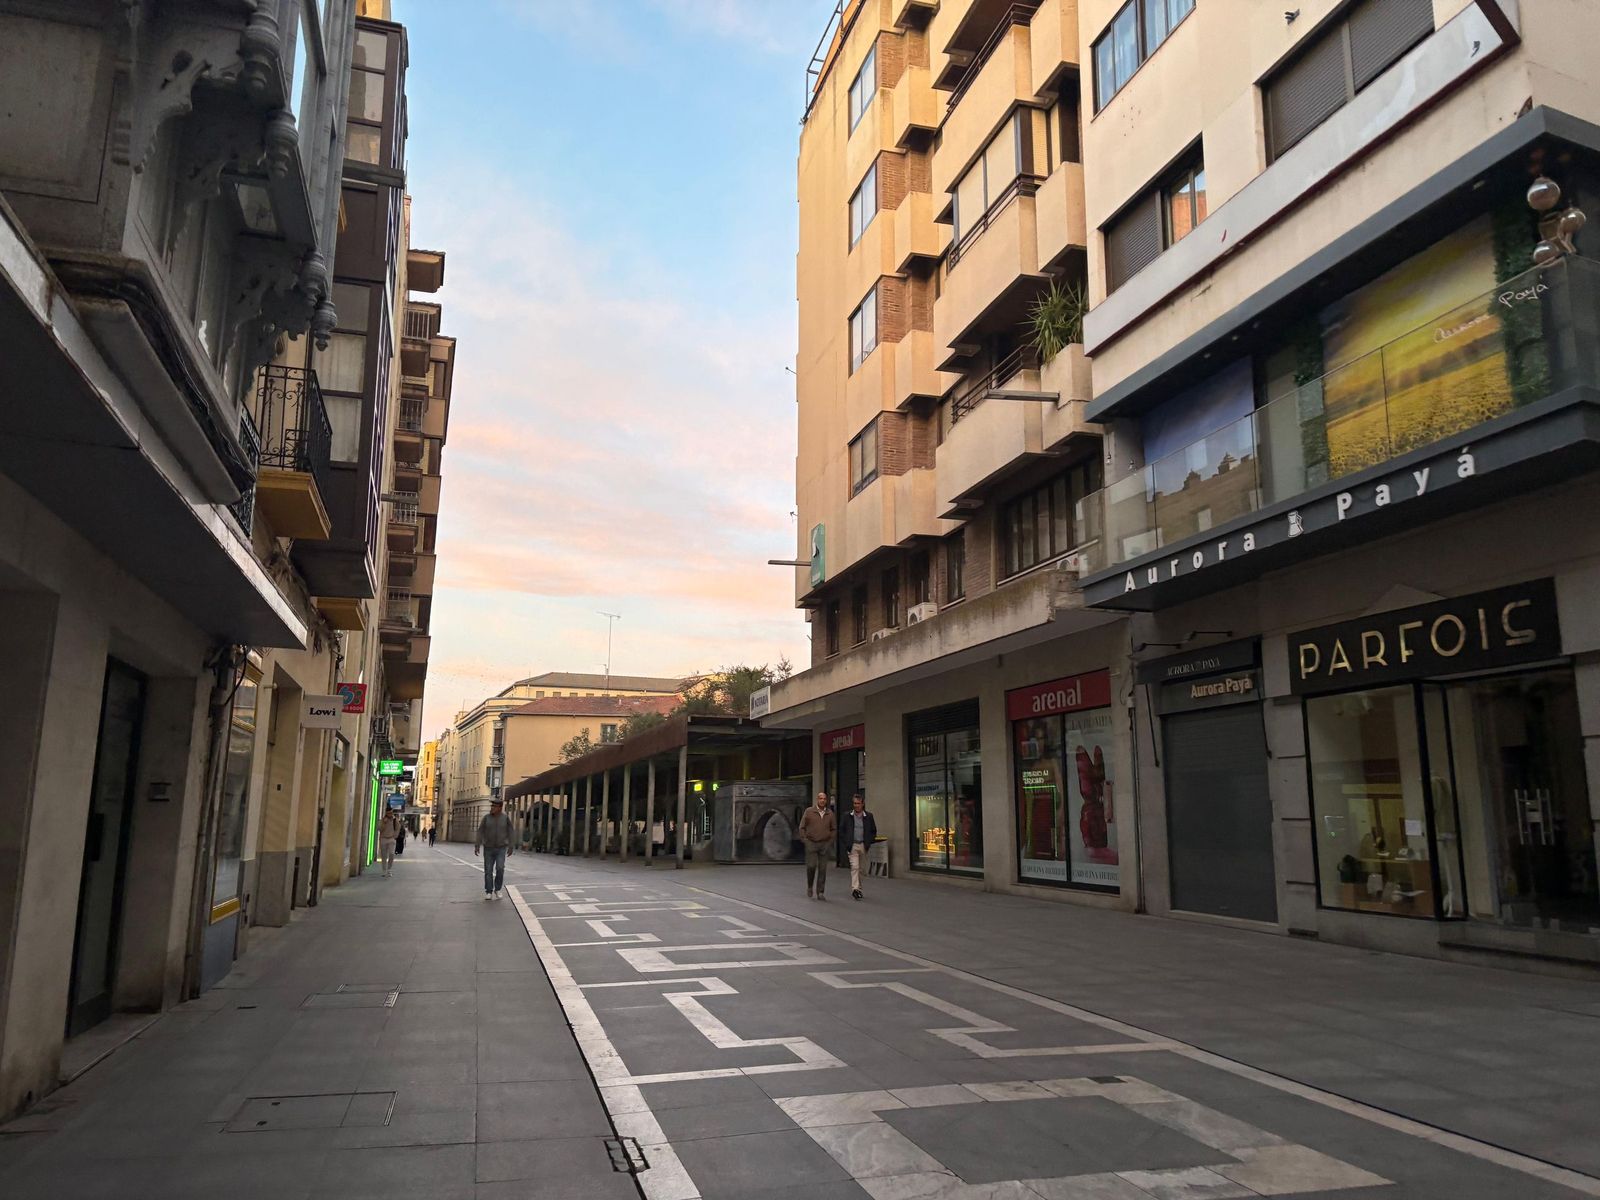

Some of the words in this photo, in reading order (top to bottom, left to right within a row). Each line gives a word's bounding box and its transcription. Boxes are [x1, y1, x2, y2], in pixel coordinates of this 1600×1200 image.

[1499, 276, 1548, 307] Payá
[1124, 532, 1256, 592] Aurora
[1337, 447, 1475, 520] Payá
[1299, 599, 1536, 679] PARFOIS
[1032, 679, 1082, 712] arenal
[1191, 682, 1225, 699] Aurora
[1226, 675, 1252, 693] Payá
[309, 707, 336, 717] Lowi
[832, 729, 853, 749] arenal
